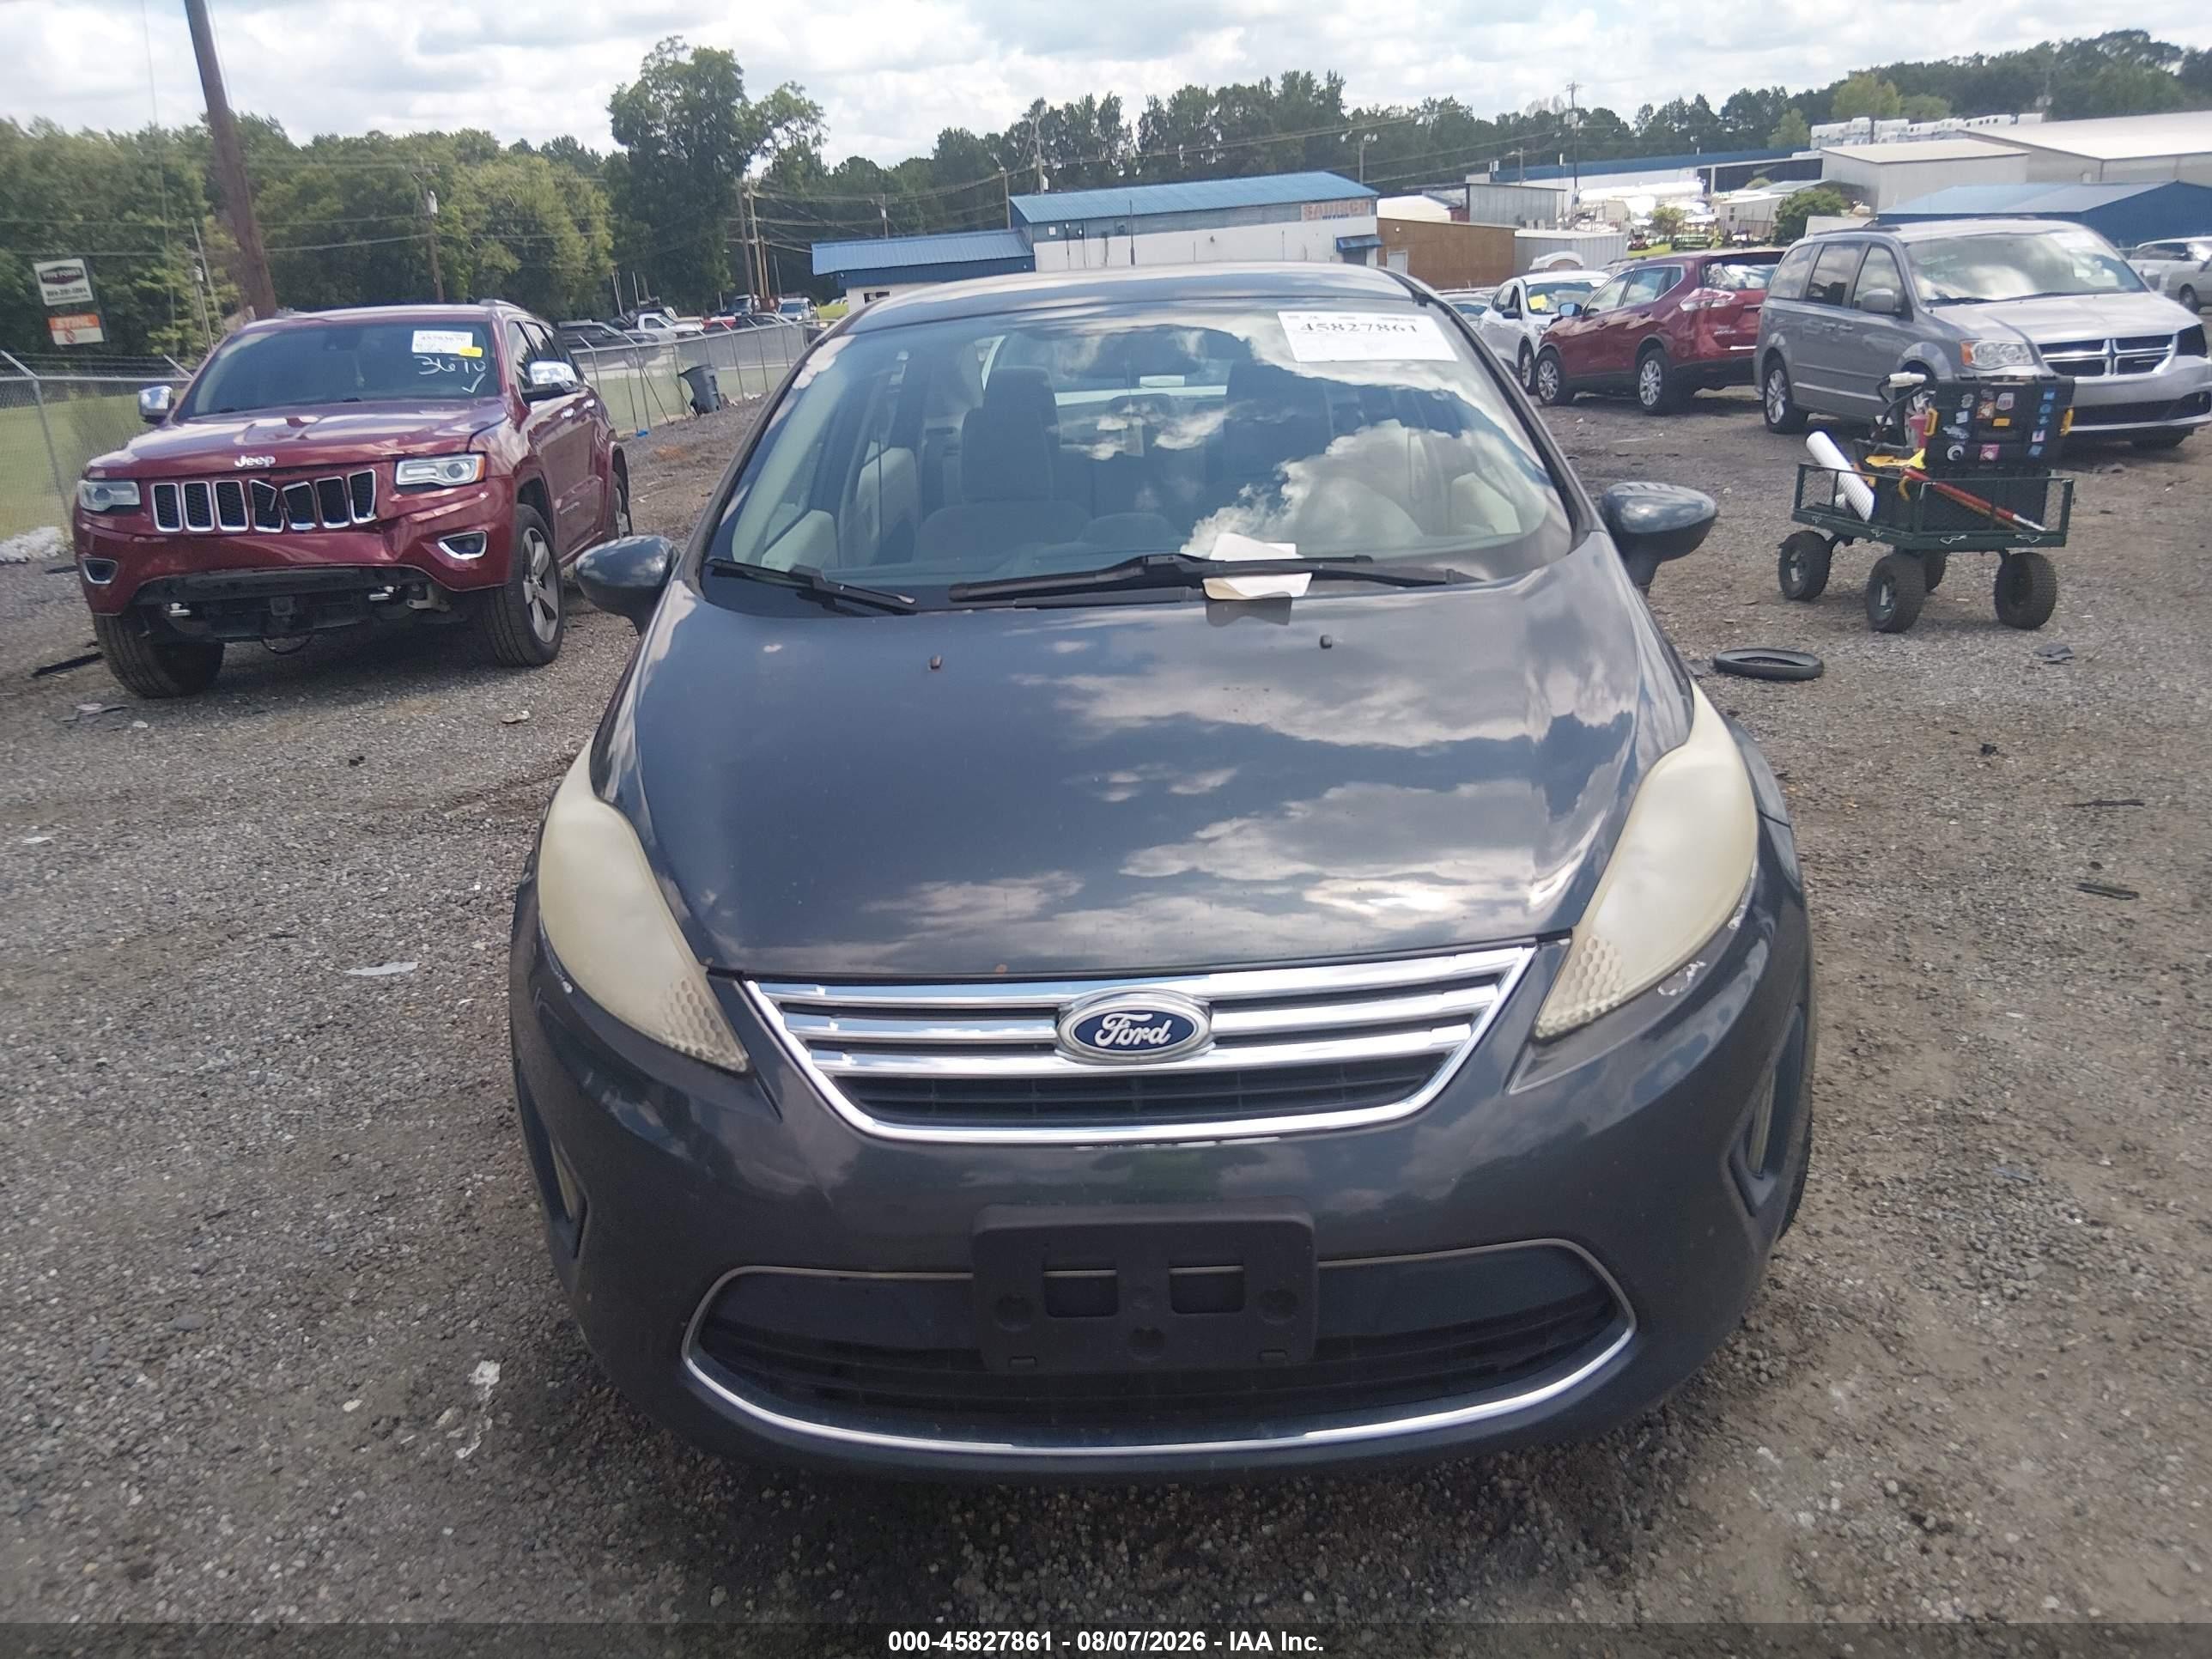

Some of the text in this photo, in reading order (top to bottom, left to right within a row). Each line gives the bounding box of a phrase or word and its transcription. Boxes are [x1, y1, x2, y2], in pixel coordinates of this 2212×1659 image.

[1299, 322, 1418, 333] 45827861
[234, 454, 276, 468] Jeep
[1094, 1012, 1173, 1047] Ford
